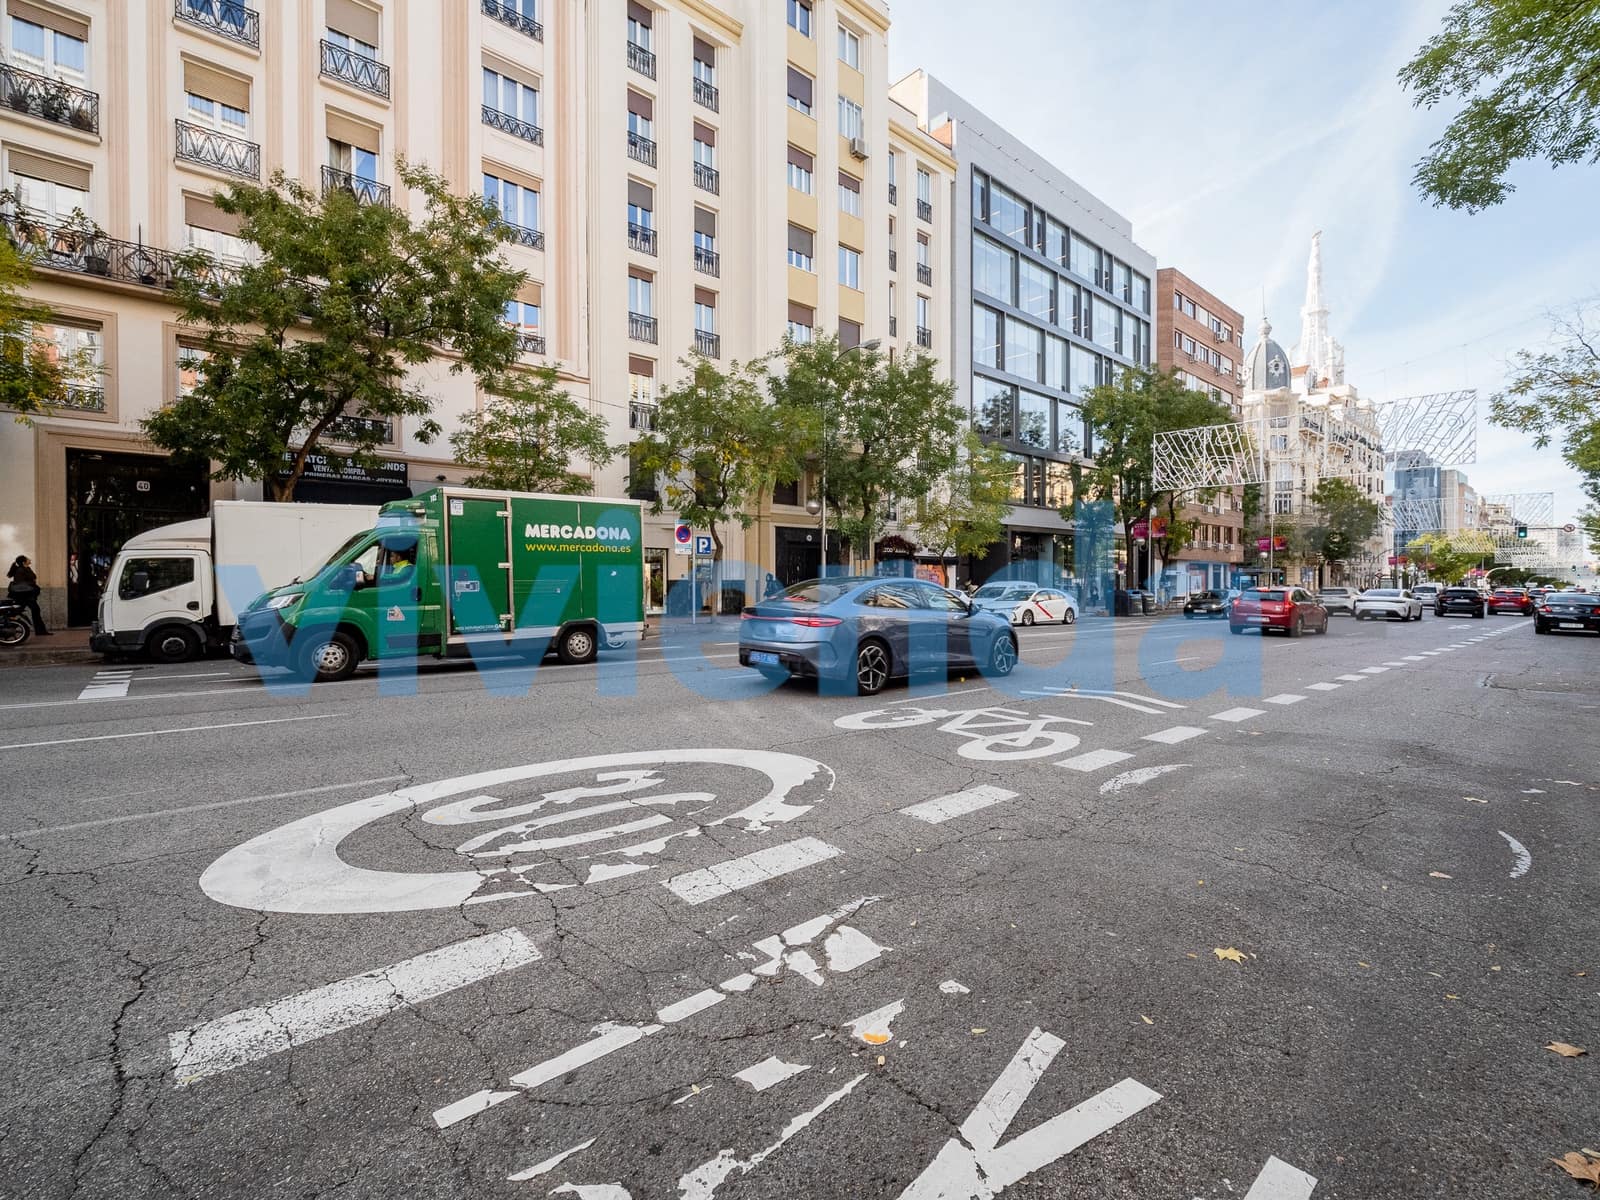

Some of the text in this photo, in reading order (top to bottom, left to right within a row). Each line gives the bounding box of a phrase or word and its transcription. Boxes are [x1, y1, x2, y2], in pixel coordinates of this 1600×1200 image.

[346, 458, 354, 468] &
[525, 524, 631, 541] MERCADONA
[525, 543, 631, 553] www.mercadona.es
[699, 538, 709, 553] P
